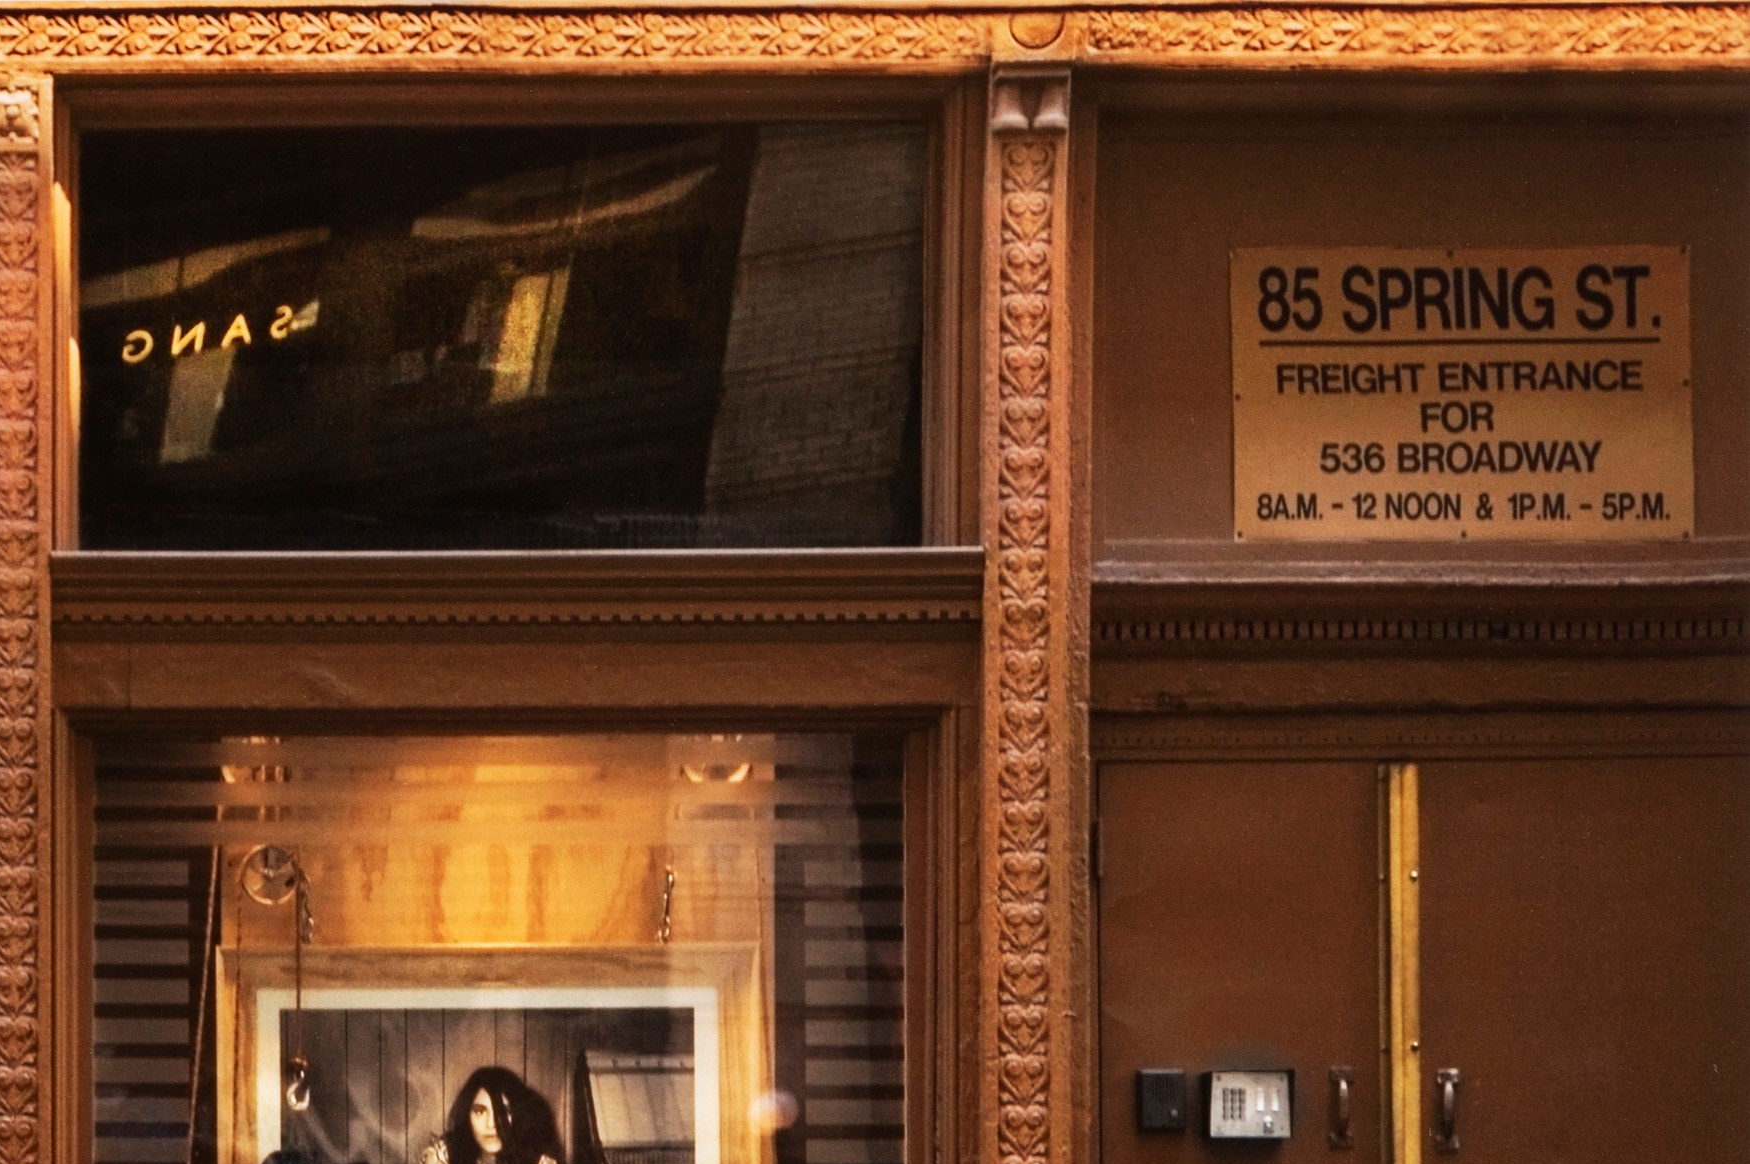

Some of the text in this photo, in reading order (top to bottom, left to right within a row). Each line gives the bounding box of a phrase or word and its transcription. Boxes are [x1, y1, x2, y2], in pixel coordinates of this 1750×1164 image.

[1258, 264, 1661, 332] 85 SPRING ST.
[1276, 360, 1643, 395] FREIGHT ENTRANCE
[1420, 401, 1494, 433] FOR
[1319, 441, 1602, 474] 536 BROADWAY
[1257, 493, 1324, 521] 8A.M.
[1352, 493, 1377, 521] 12
[1385, 492, 1461, 521] NOON
[1476, 493, 1494, 521] &
[1507, 493, 1571, 521] 1P.M.
[1602, 492, 1670, 521] 5P.M.
